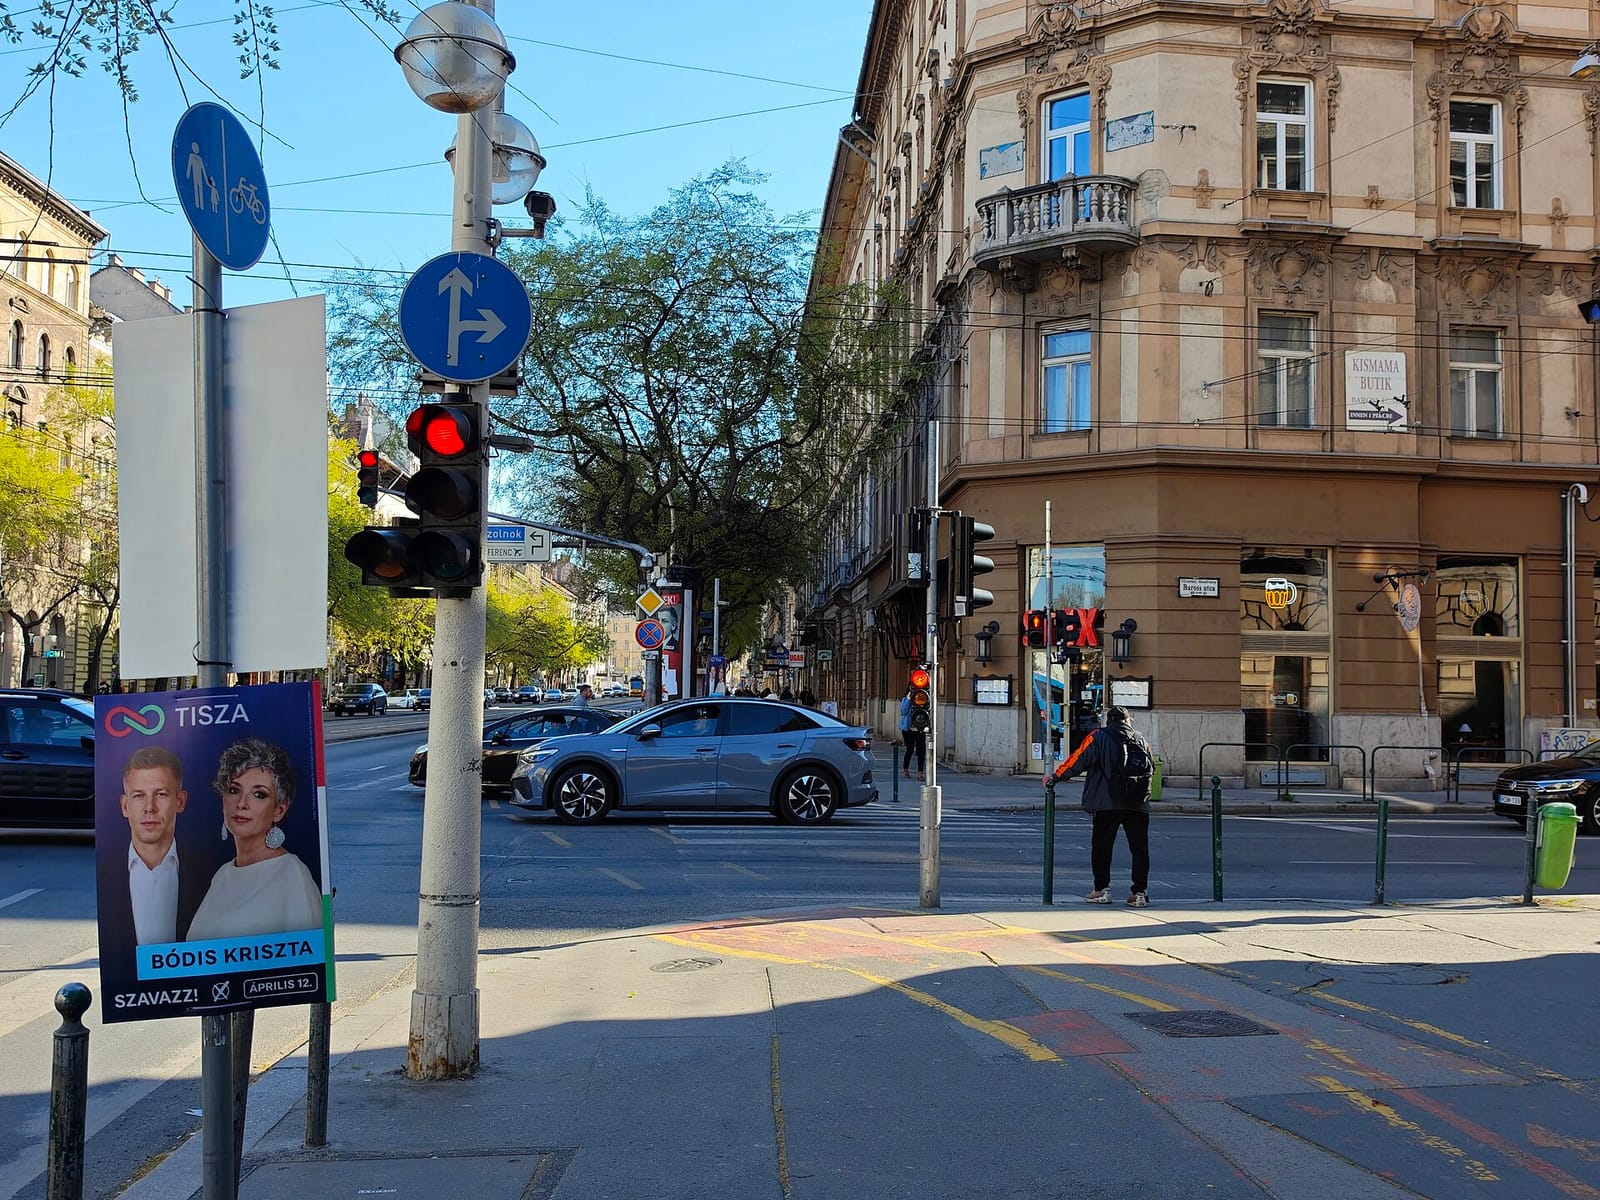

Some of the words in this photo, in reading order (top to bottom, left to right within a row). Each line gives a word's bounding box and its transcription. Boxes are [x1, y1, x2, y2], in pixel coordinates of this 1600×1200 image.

[1352, 358, 1400, 373] KISMAMA
[1360, 376, 1392, 391] BUTIK
[487, 528, 522, 539] zolnok
[487, 548, 513, 556] FERENC
[663, 595, 676, 606] EK!
[175, 703, 250, 728] TISZA
[151, 948, 217, 970] BÓDIS
[224, 940, 313, 964] KRISZTA
[114, 988, 198, 1009] SZAVAZZ!
[249, 979, 295, 994] ÁPRILIS
[297, 978, 313, 989] 12.
